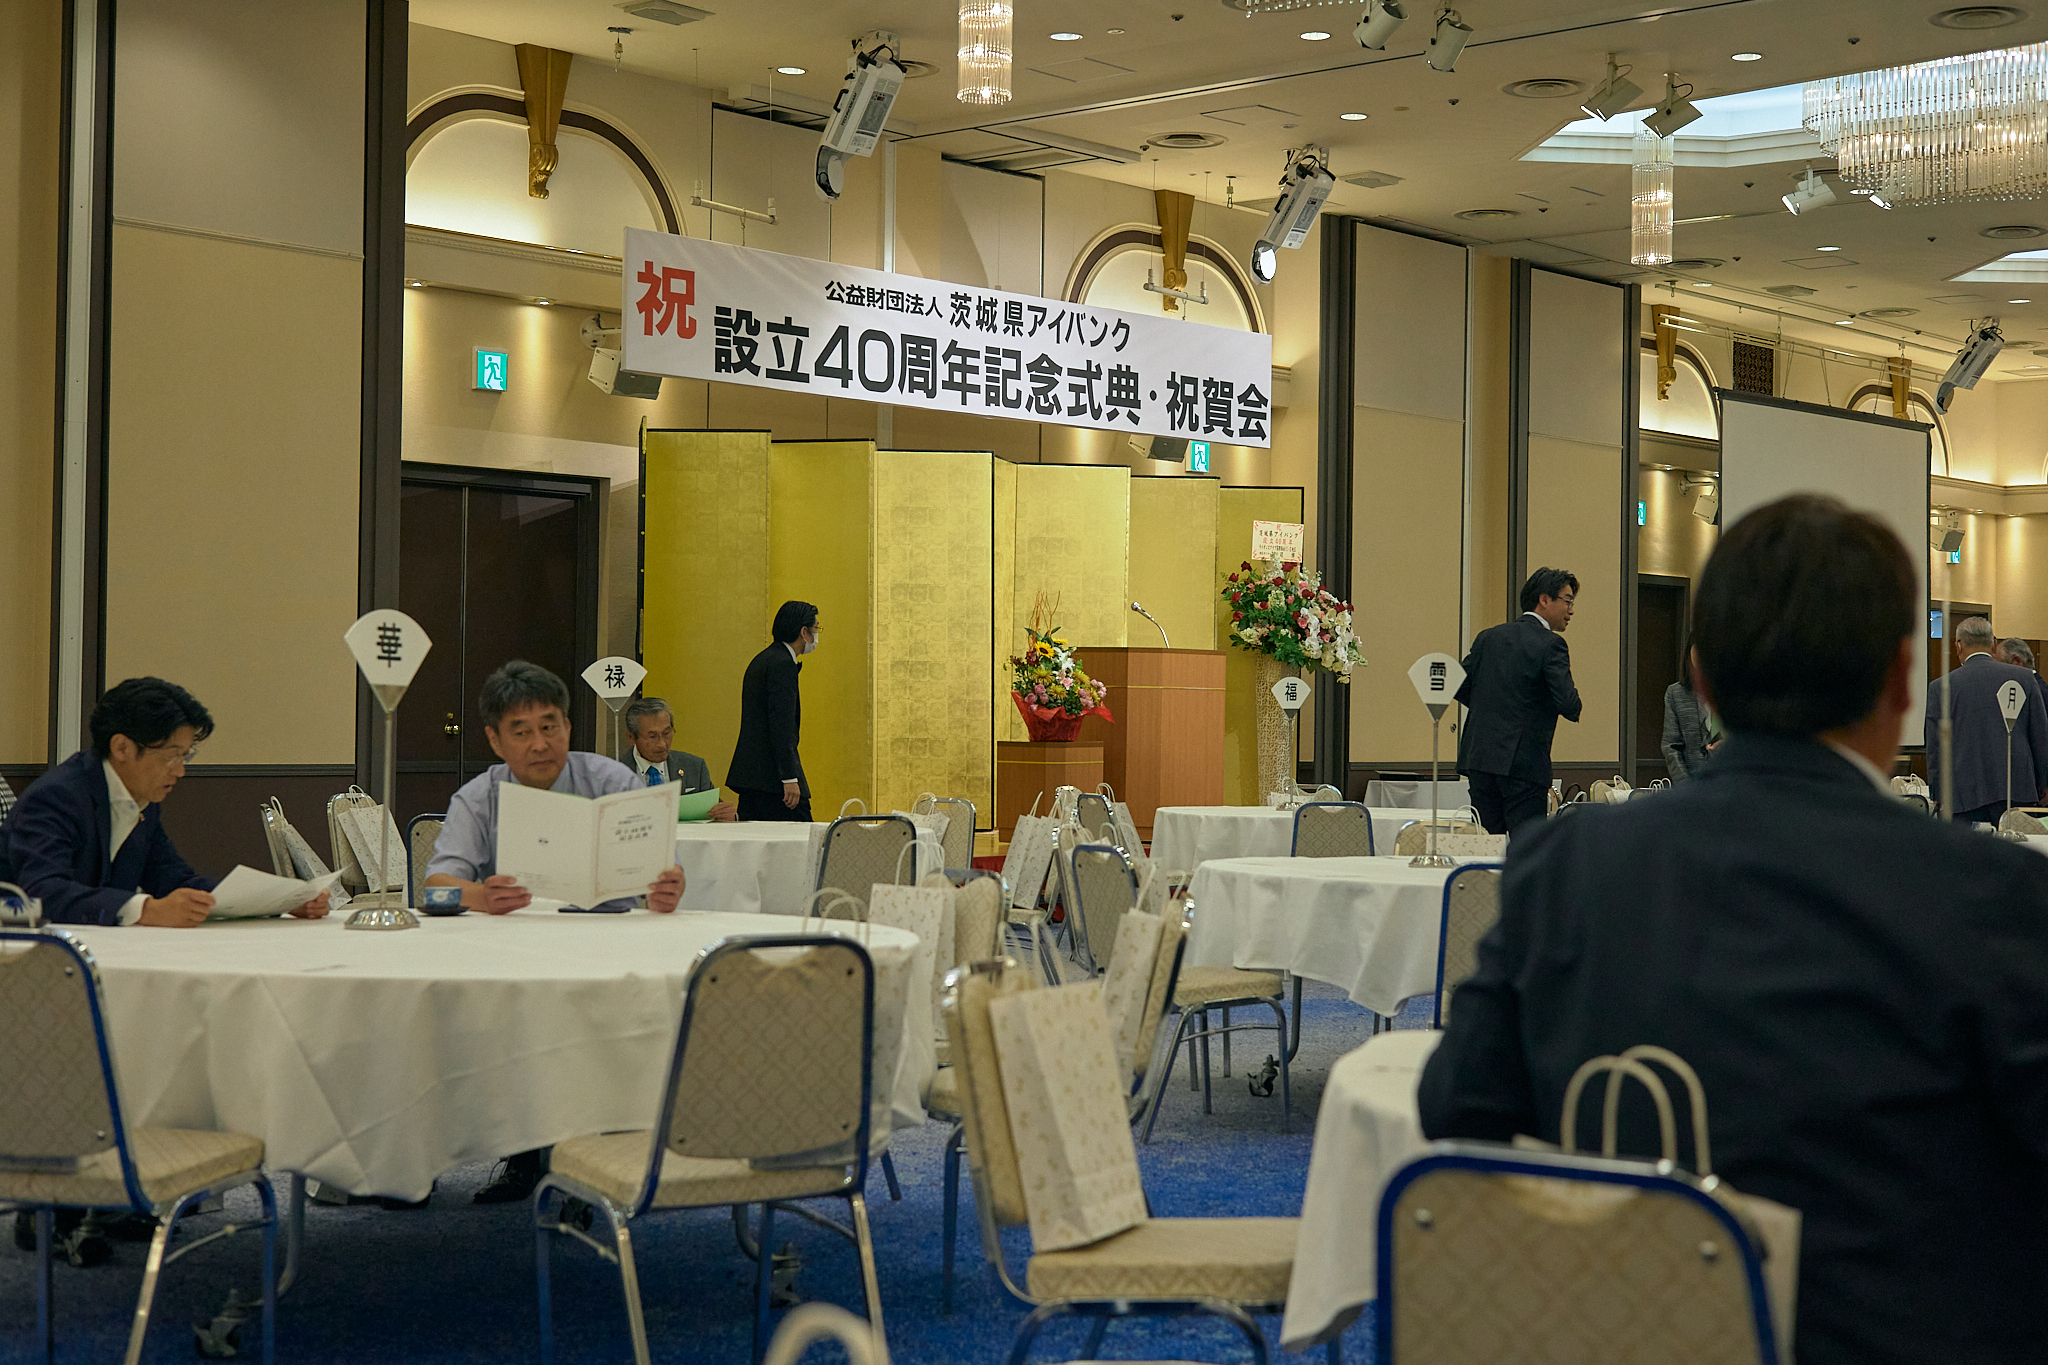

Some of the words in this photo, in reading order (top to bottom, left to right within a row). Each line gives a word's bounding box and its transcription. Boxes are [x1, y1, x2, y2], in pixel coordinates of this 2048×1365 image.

[636, 260, 697, 340] 祝
[825, 280, 944, 319] 公益財団法人
[949, 290, 1131, 353] 茨城県アイバンク
[713, 305, 1269, 442] 設立40周年記念式典・祝賀会
[376, 622, 402, 668] 華
[604, 664, 626, 689] 禄
[1284, 682, 1298, 701] 福
[1429, 662, 1446, 691] 雪
[2007, 687, 2017, 710] 月
